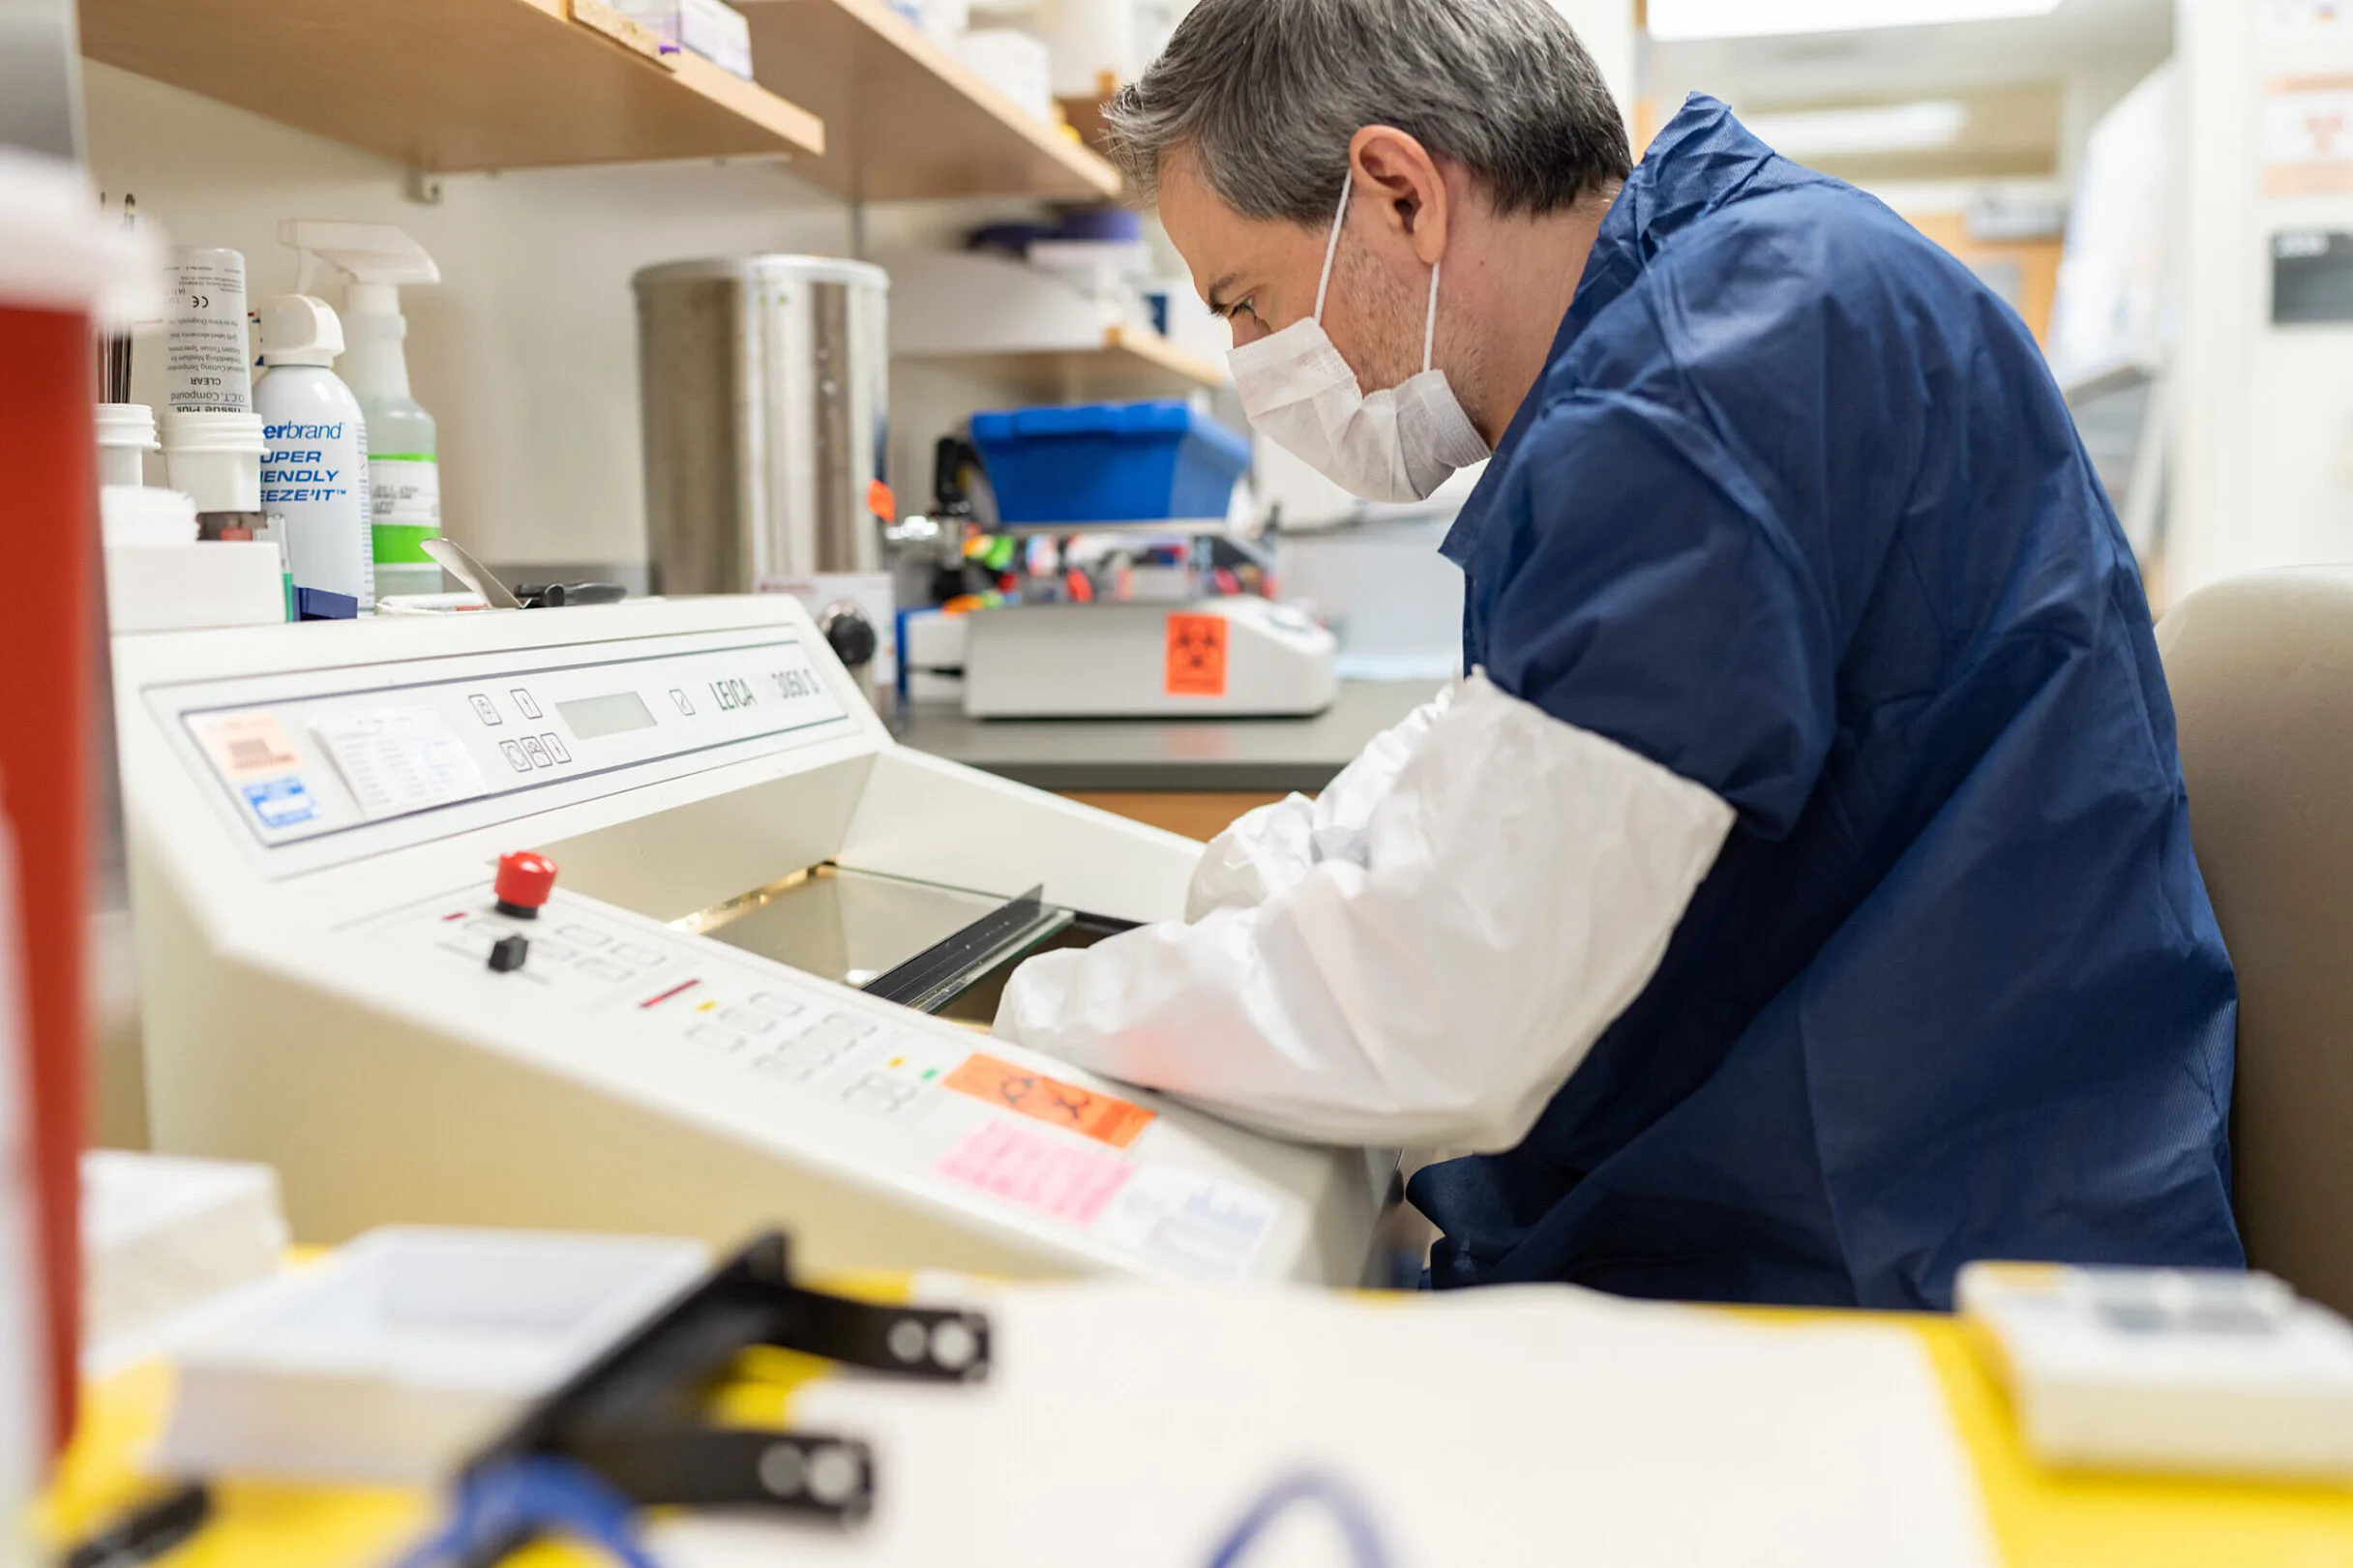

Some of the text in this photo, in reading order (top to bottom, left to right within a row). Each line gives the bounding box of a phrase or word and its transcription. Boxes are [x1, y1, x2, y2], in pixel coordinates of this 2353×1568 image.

[190, 376, 222, 386] CLEAR
[169, 390, 220, 402] Compound
[263, 420, 343, 439] erbrand
[260, 451, 322, 463] UPER
[259, 470, 340, 483] IENDLY
[708, 677, 759, 711] LEICA
